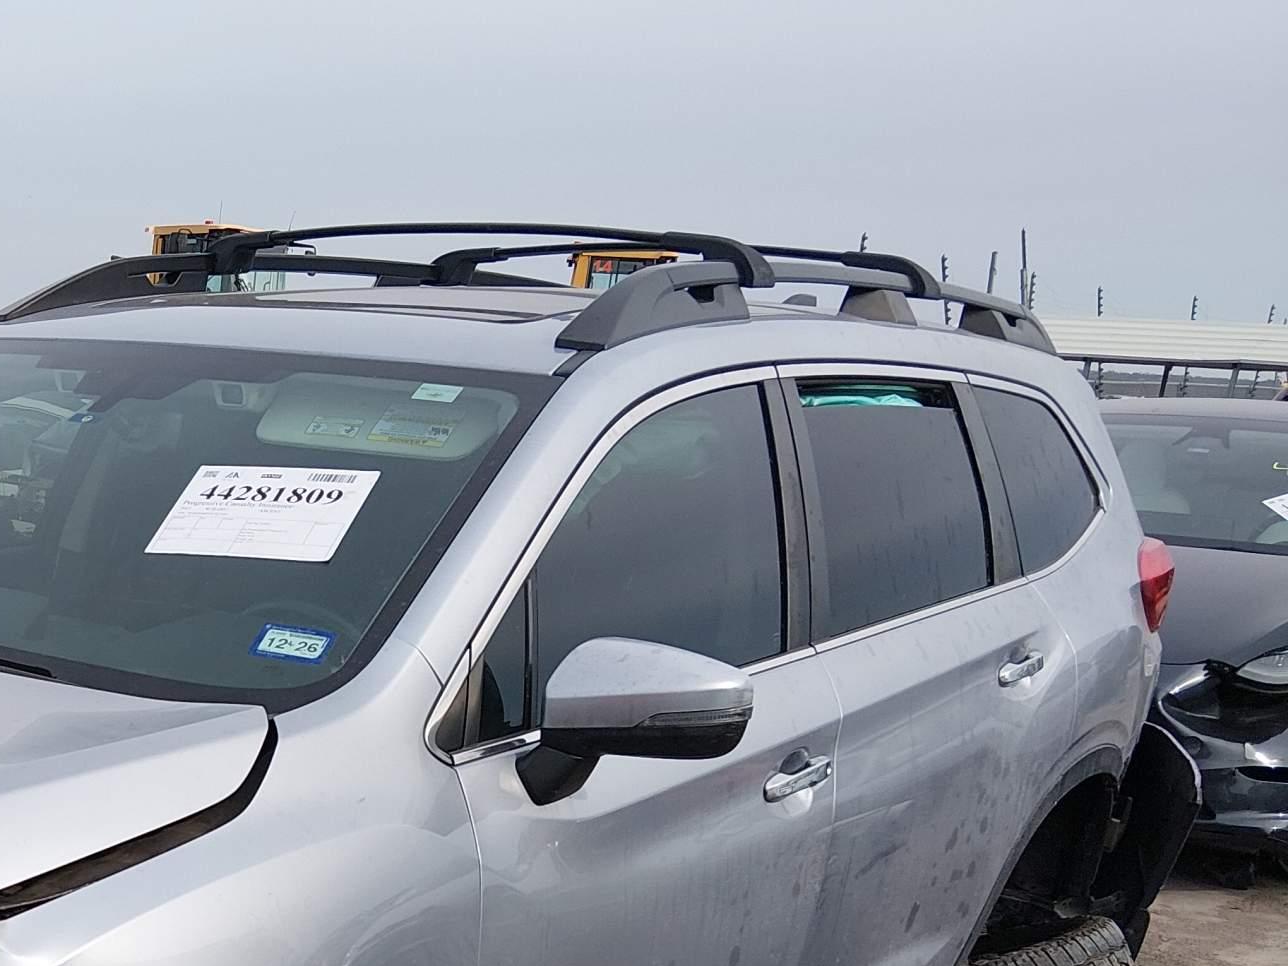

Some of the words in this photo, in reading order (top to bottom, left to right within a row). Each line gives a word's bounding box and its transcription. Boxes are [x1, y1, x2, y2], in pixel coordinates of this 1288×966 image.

[594, 259, 612, 272] 14
[199, 484, 344, 505] 44281809
[267, 637, 289, 650] 12
[294, 641, 319, 653] 26
